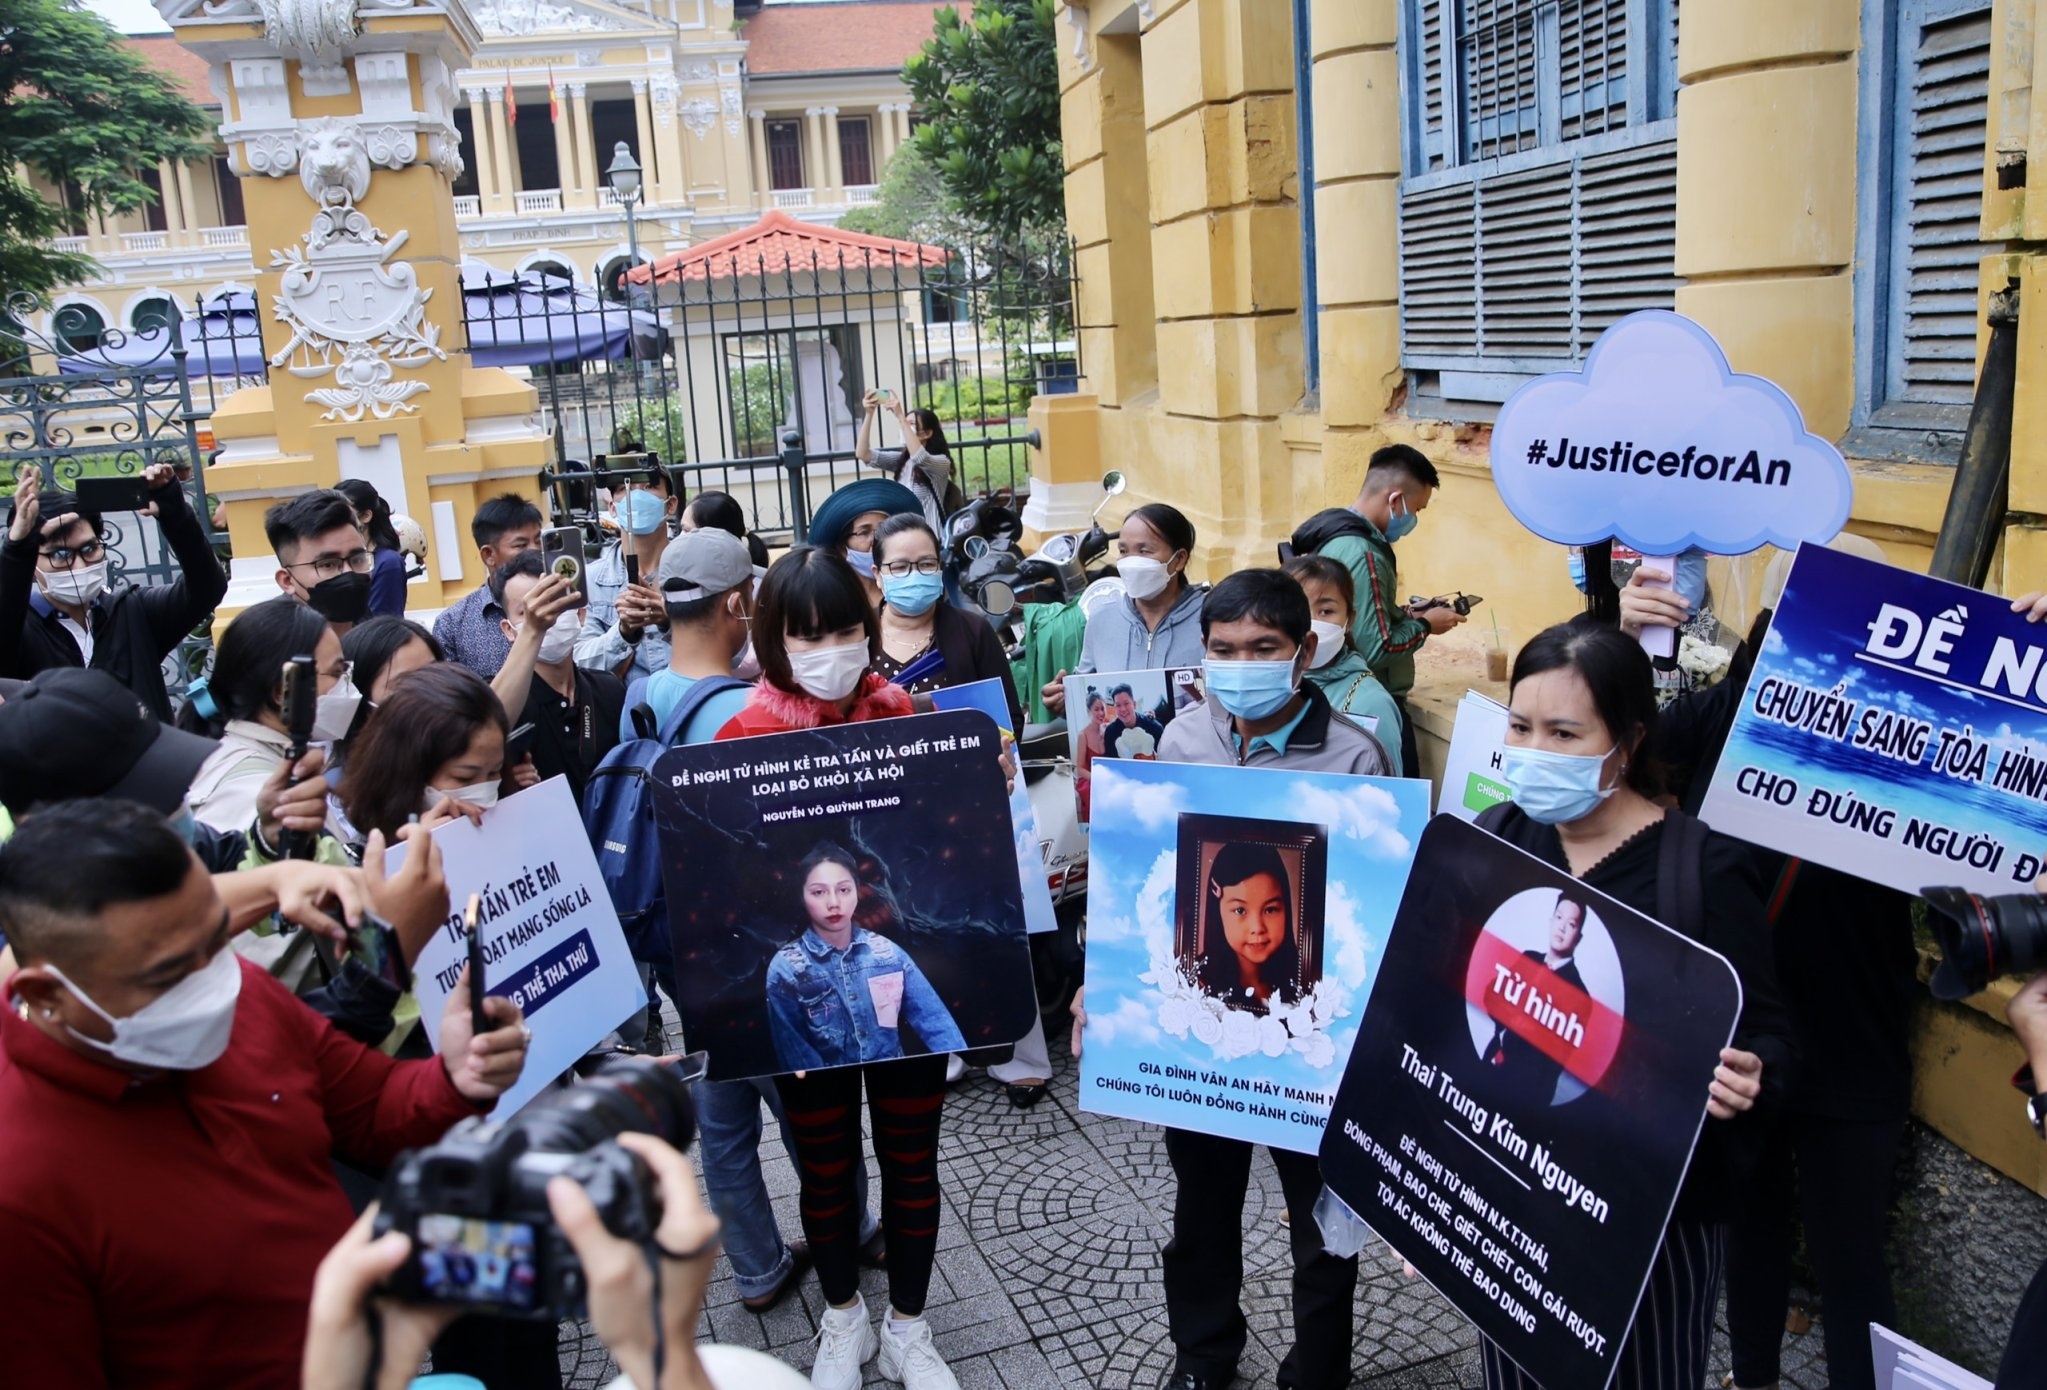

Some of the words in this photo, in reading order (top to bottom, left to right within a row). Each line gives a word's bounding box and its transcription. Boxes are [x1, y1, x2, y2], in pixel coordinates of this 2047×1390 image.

[1527, 438, 1792, 486] #JusticeforAn
[1865, 602, 1969, 675] ĐỀ
[1177, 673, 1190, 682] HD
[672, 769, 690, 787] ĐỀ
[694, 768, 730, 784] NGHỊ
[733, 764, 752, 779] TỬ
[755, 760, 790, 776] HÌNH
[794, 754, 811, 771] KẺ
[814, 754, 840, 769] TRA
[843, 745, 871, 765] TẤN
[874, 744, 896, 760] VÀ
[899, 738, 930, 758] GIẾT
[933, 735, 957, 752] TRẺ
[960, 736, 981, 749] EM
[1491, 751, 1502, 771] H
[1754, 678, 1854, 740] CHUYỂN
[1854, 709, 1930, 761] SANG
[1932, 727, 1989, 782] TÒA
[752, 781, 785, 797] LOẠI
[789, 774, 810, 791] BỎ
[814, 770, 850, 788] KHỎI
[853, 767, 874, 783] XÃ
[877, 765, 904, 782] HỘI
[763, 805, 806, 823] NGUYỄN
[807, 803, 824, 816] VÕ
[826, 799, 864, 814] QUỲNH
[865, 796, 901, 809] TRANG
[1477, 782, 1505, 802] CHÚNG
[1736, 767, 1798, 806] CHO
[1807, 790, 1896, 838] ĐÚNG
[1902, 818, 2004, 873] NGƯỜI
[2012, 853, 2046, 884] Đ
[444, 907, 468, 944] TR
[479, 882, 511, 925] TẤN
[508, 865, 538, 906] TRẺ
[536, 862, 561, 891] EM
[482, 935, 508, 966] OẠT
[506, 914, 544, 950] MẠNG
[543, 895, 577, 927] SỐNG
[575, 883, 592, 908] LÀ
[523, 965, 547, 1002] THỂ
[543, 961, 569, 988] THA
[565, 942, 589, 972] THỨ
[1493, 963, 1527, 1006] Tử
[1524, 986, 1584, 1048] hình
[1096, 1073, 1142, 1094] CHÚNG
[1145, 1083, 1165, 1099] TÔI
[1168, 1088, 1202, 1105] LUÔN
[1205, 1092, 1245, 1113] ĐỒNG
[1248, 1101, 1287, 1121] HÀNH
[1290, 1110, 1328, 1129] CÙNG
[1139, 1062, 1161, 1076] GIA
[1165, 1064, 1197, 1082] ĐÌNH
[1200, 1070, 1227, 1087] VÂN
[1231, 1078, 1250, 1092] AN
[1253, 1080, 1280, 1096] HÃY
[1284, 1087, 1325, 1105] MẠNH
[1400, 1043, 1437, 1089] Thai
[1439, 1072, 1488, 1134] Trung
[1489, 1113, 1528, 1161] Kim
[1529, 1144, 1609, 1224] Nguyen
[1372, 1143, 1402, 1182] PHẠM,
[1403, 1170, 1427, 1199] BAO
[1428, 1192, 1452, 1226] CHE,
[1514, 1266, 1542, 1299] CON
[1542, 1291, 1567, 1321] GÁI
[1415, 1147, 1443, 1183] NGHỊ
[1459, 1184, 1488, 1218] HÌNH
[1487, 1207, 1549, 1274] N.K.T.THÁI,
[1377, 1181, 1396, 1207] TỘI
[1393, 1195, 1411, 1220] ÁC
[1410, 1211, 1450, 1256] KHÔNG
[1473, 1267, 1500, 1300] BAO
[1500, 1292, 1537, 1333] DUNG
